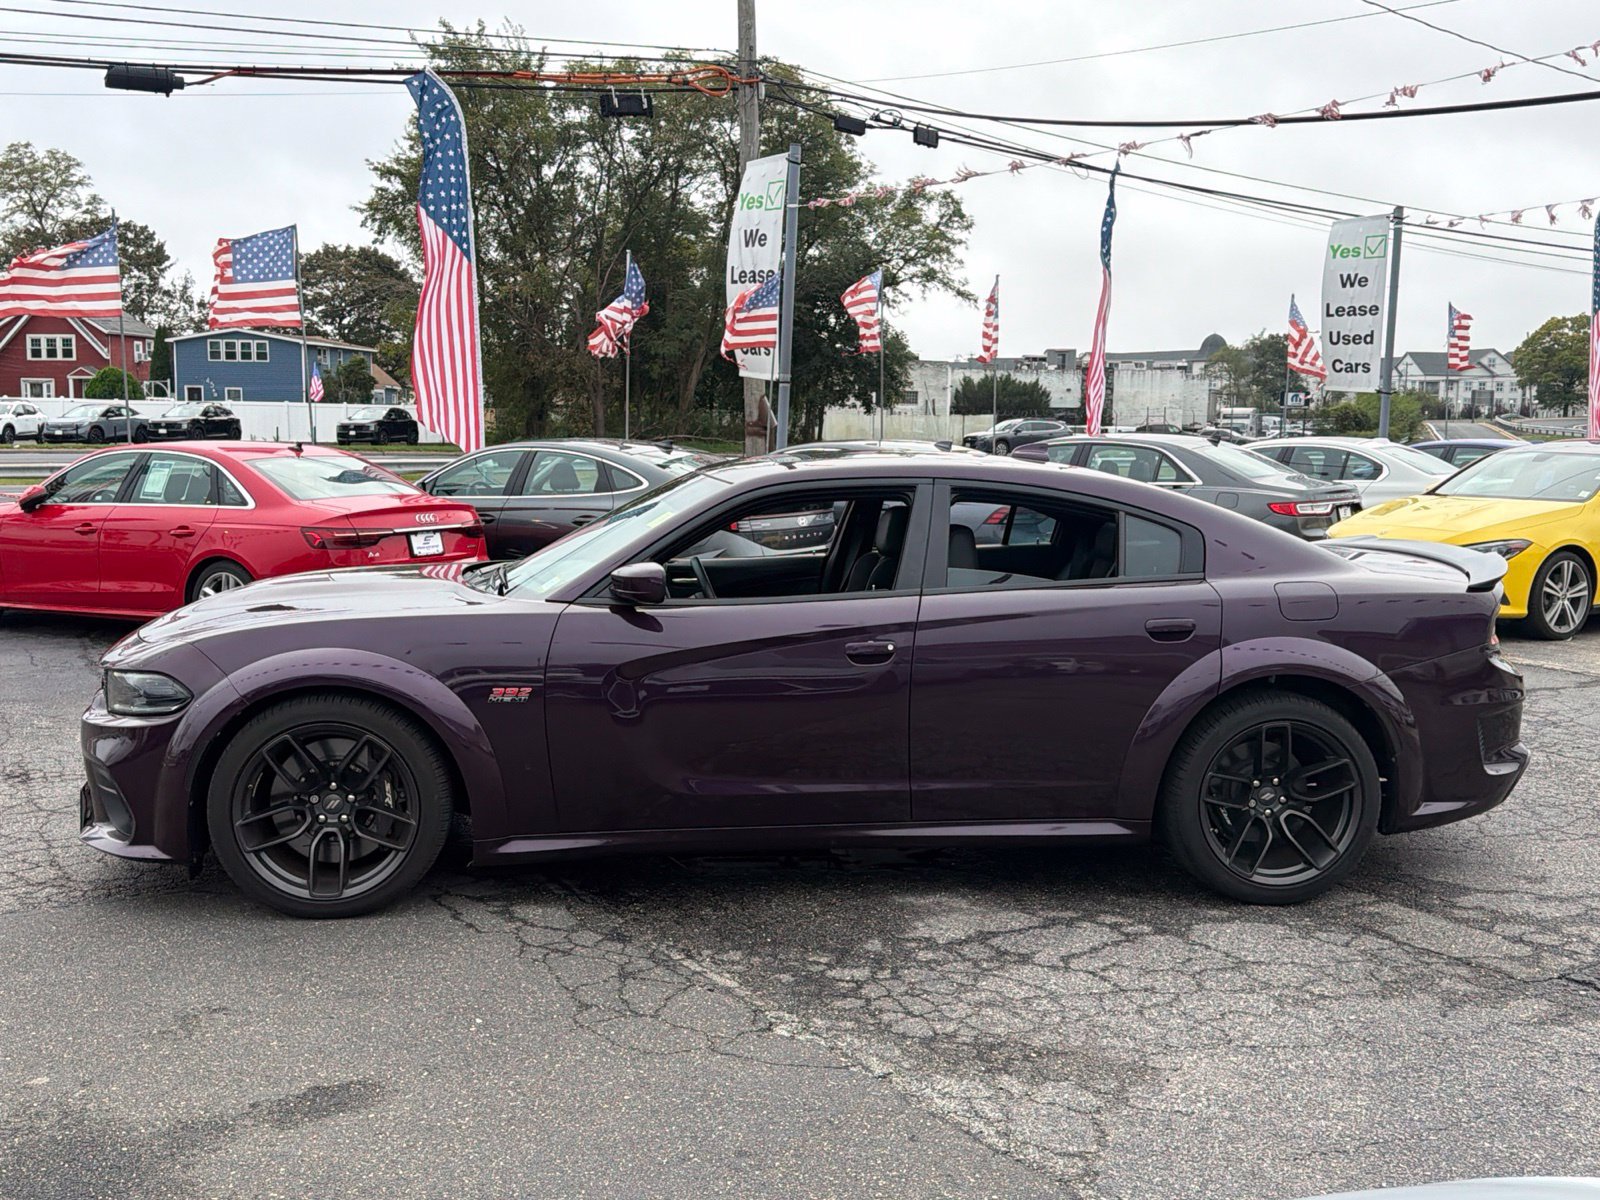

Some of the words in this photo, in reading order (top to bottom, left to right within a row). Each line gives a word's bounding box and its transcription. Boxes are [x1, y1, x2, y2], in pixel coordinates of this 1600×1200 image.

[739, 192, 764, 211] Yes
[743, 228, 768, 248] We
[1330, 244, 1361, 259] Yes
[730, 265, 776, 285] Lease
[1339, 273, 1369, 289] We
[1325, 303, 1380, 318] Lease
[1328, 330, 1375, 346] Used
[1331, 359, 1371, 374] Cars
[489, 687, 533, 697] 392
